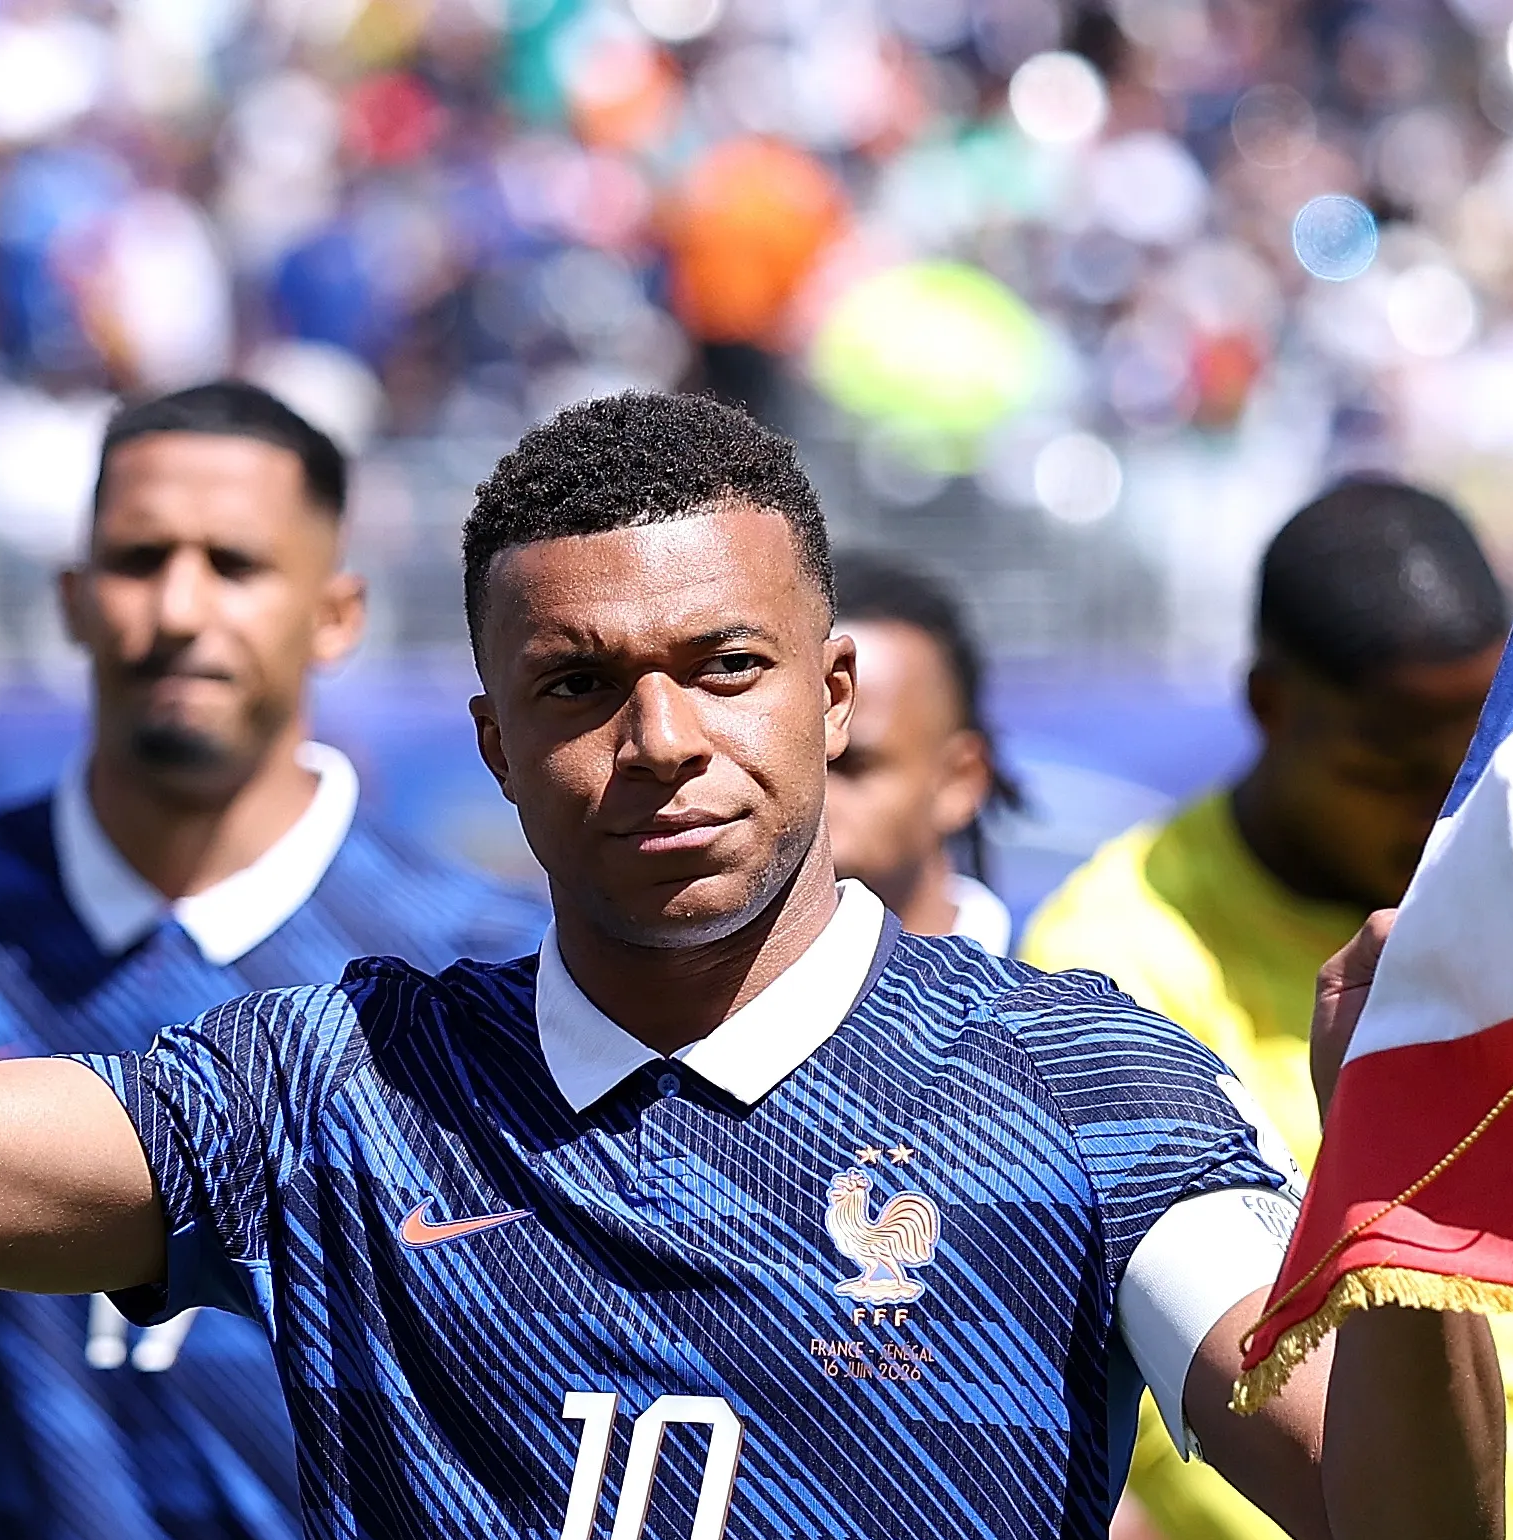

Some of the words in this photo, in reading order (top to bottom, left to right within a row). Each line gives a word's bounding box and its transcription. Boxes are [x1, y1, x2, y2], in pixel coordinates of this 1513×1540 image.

[853, 1308, 909, 1327] FFF
[810, 1338, 864, 1359] FRANCE
[879, 1340, 935, 1363] SÉNÉGAL
[823, 1358, 839, 1377] 16
[844, 1360, 873, 1380] JUIN
[878, 1362, 922, 1381] 2026
